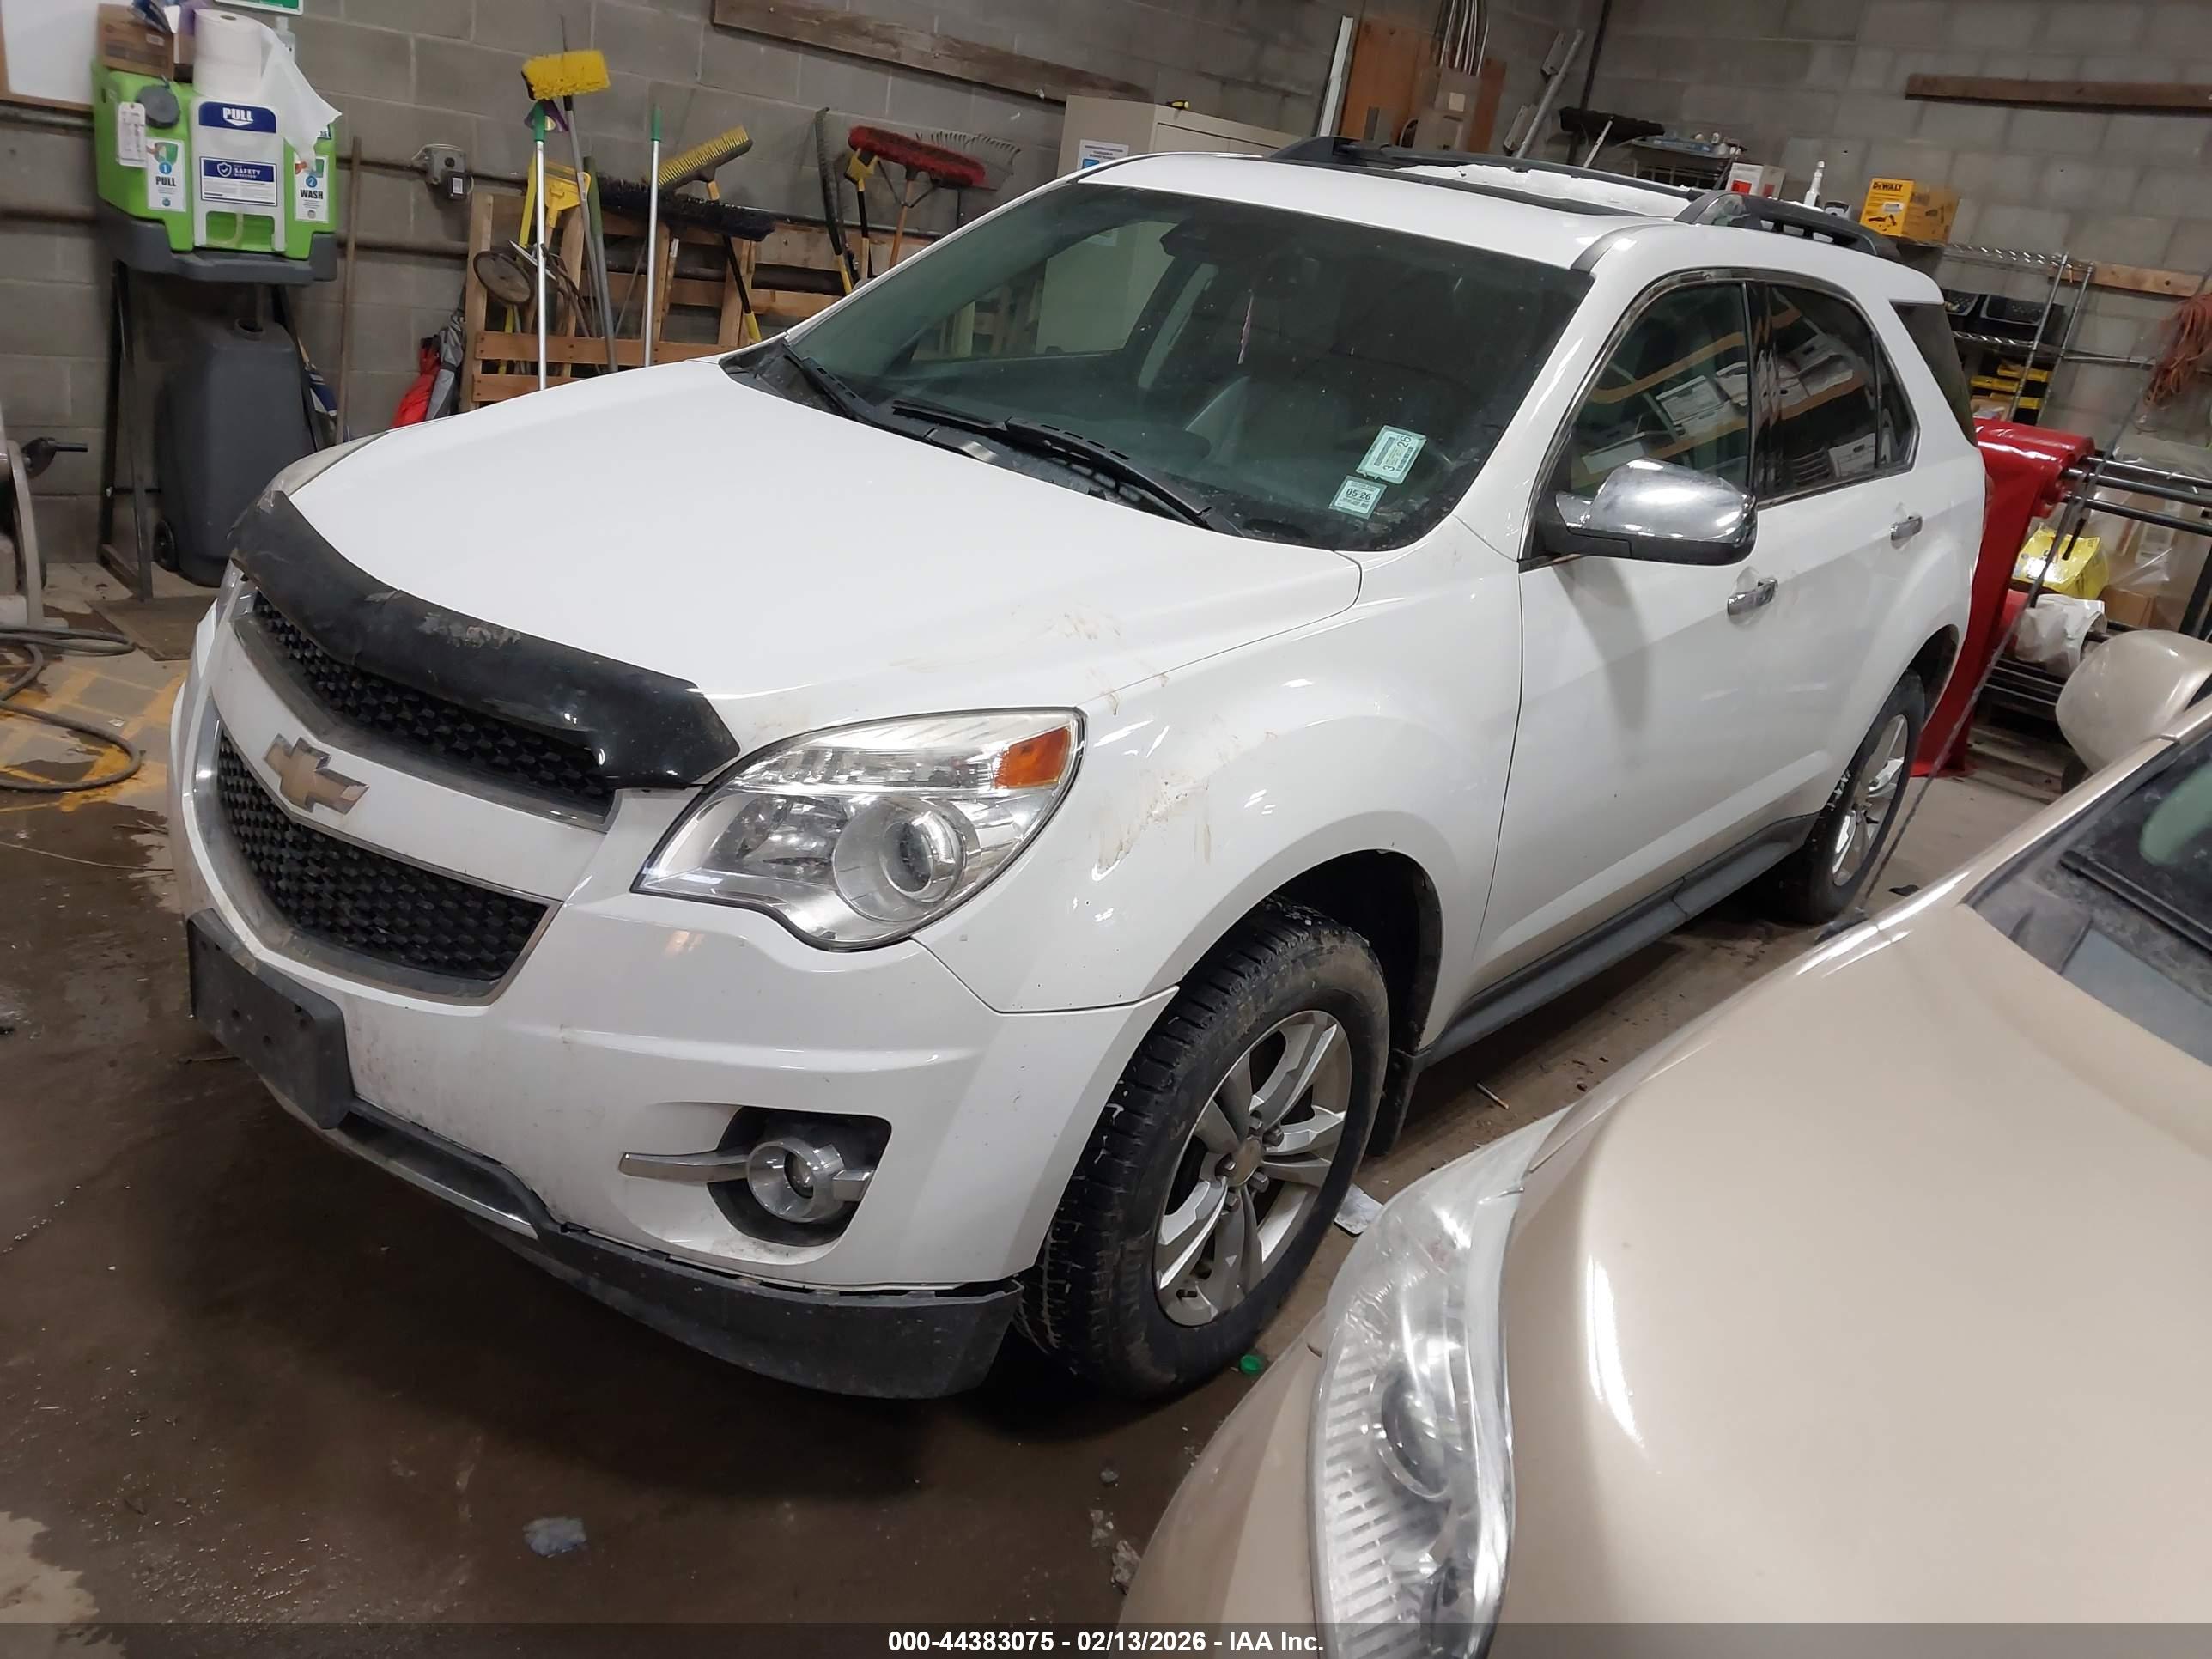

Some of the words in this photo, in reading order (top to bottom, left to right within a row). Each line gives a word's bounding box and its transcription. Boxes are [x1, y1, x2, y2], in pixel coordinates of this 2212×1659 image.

[222, 107, 254, 123] PULL
[234, 167, 261, 176] SAFETY
[155, 176, 177, 186] PULL
[1873, 182, 1904, 191] DEWALT
[300, 189, 324, 200] WASH
[1396, 435, 1412, 447] 26
